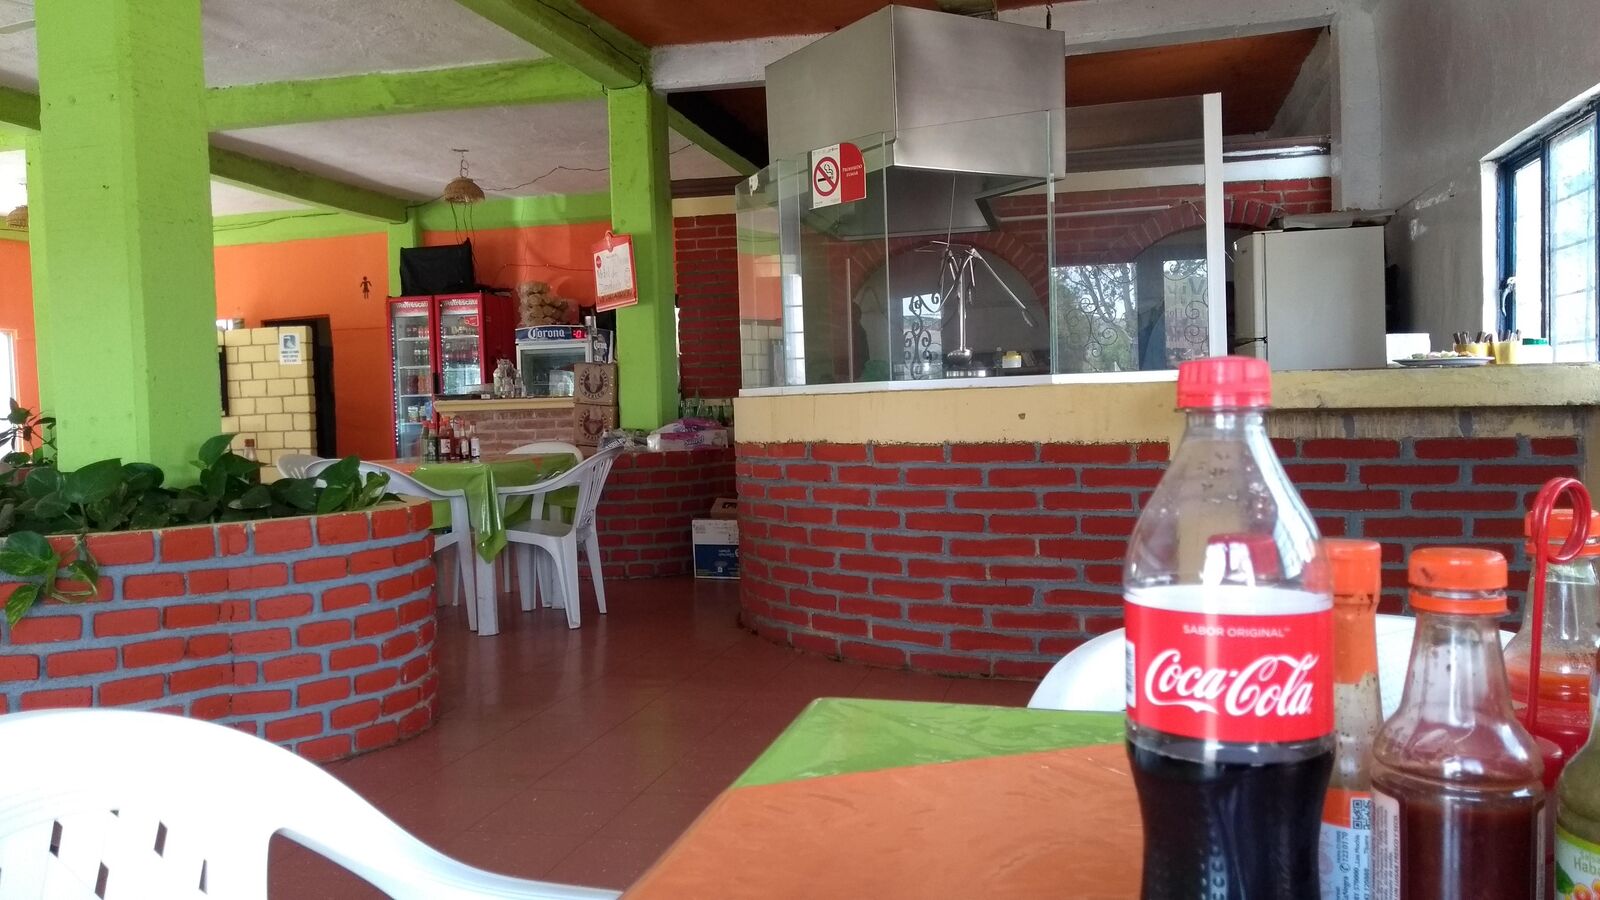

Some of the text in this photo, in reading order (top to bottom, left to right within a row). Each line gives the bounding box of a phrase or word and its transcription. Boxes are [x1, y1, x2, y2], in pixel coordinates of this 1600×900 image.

[527, 327, 565, 340] Corona
[1182, 624, 1225, 637] SABOR
[1144, 649, 1320, 717] Coca-Cola
